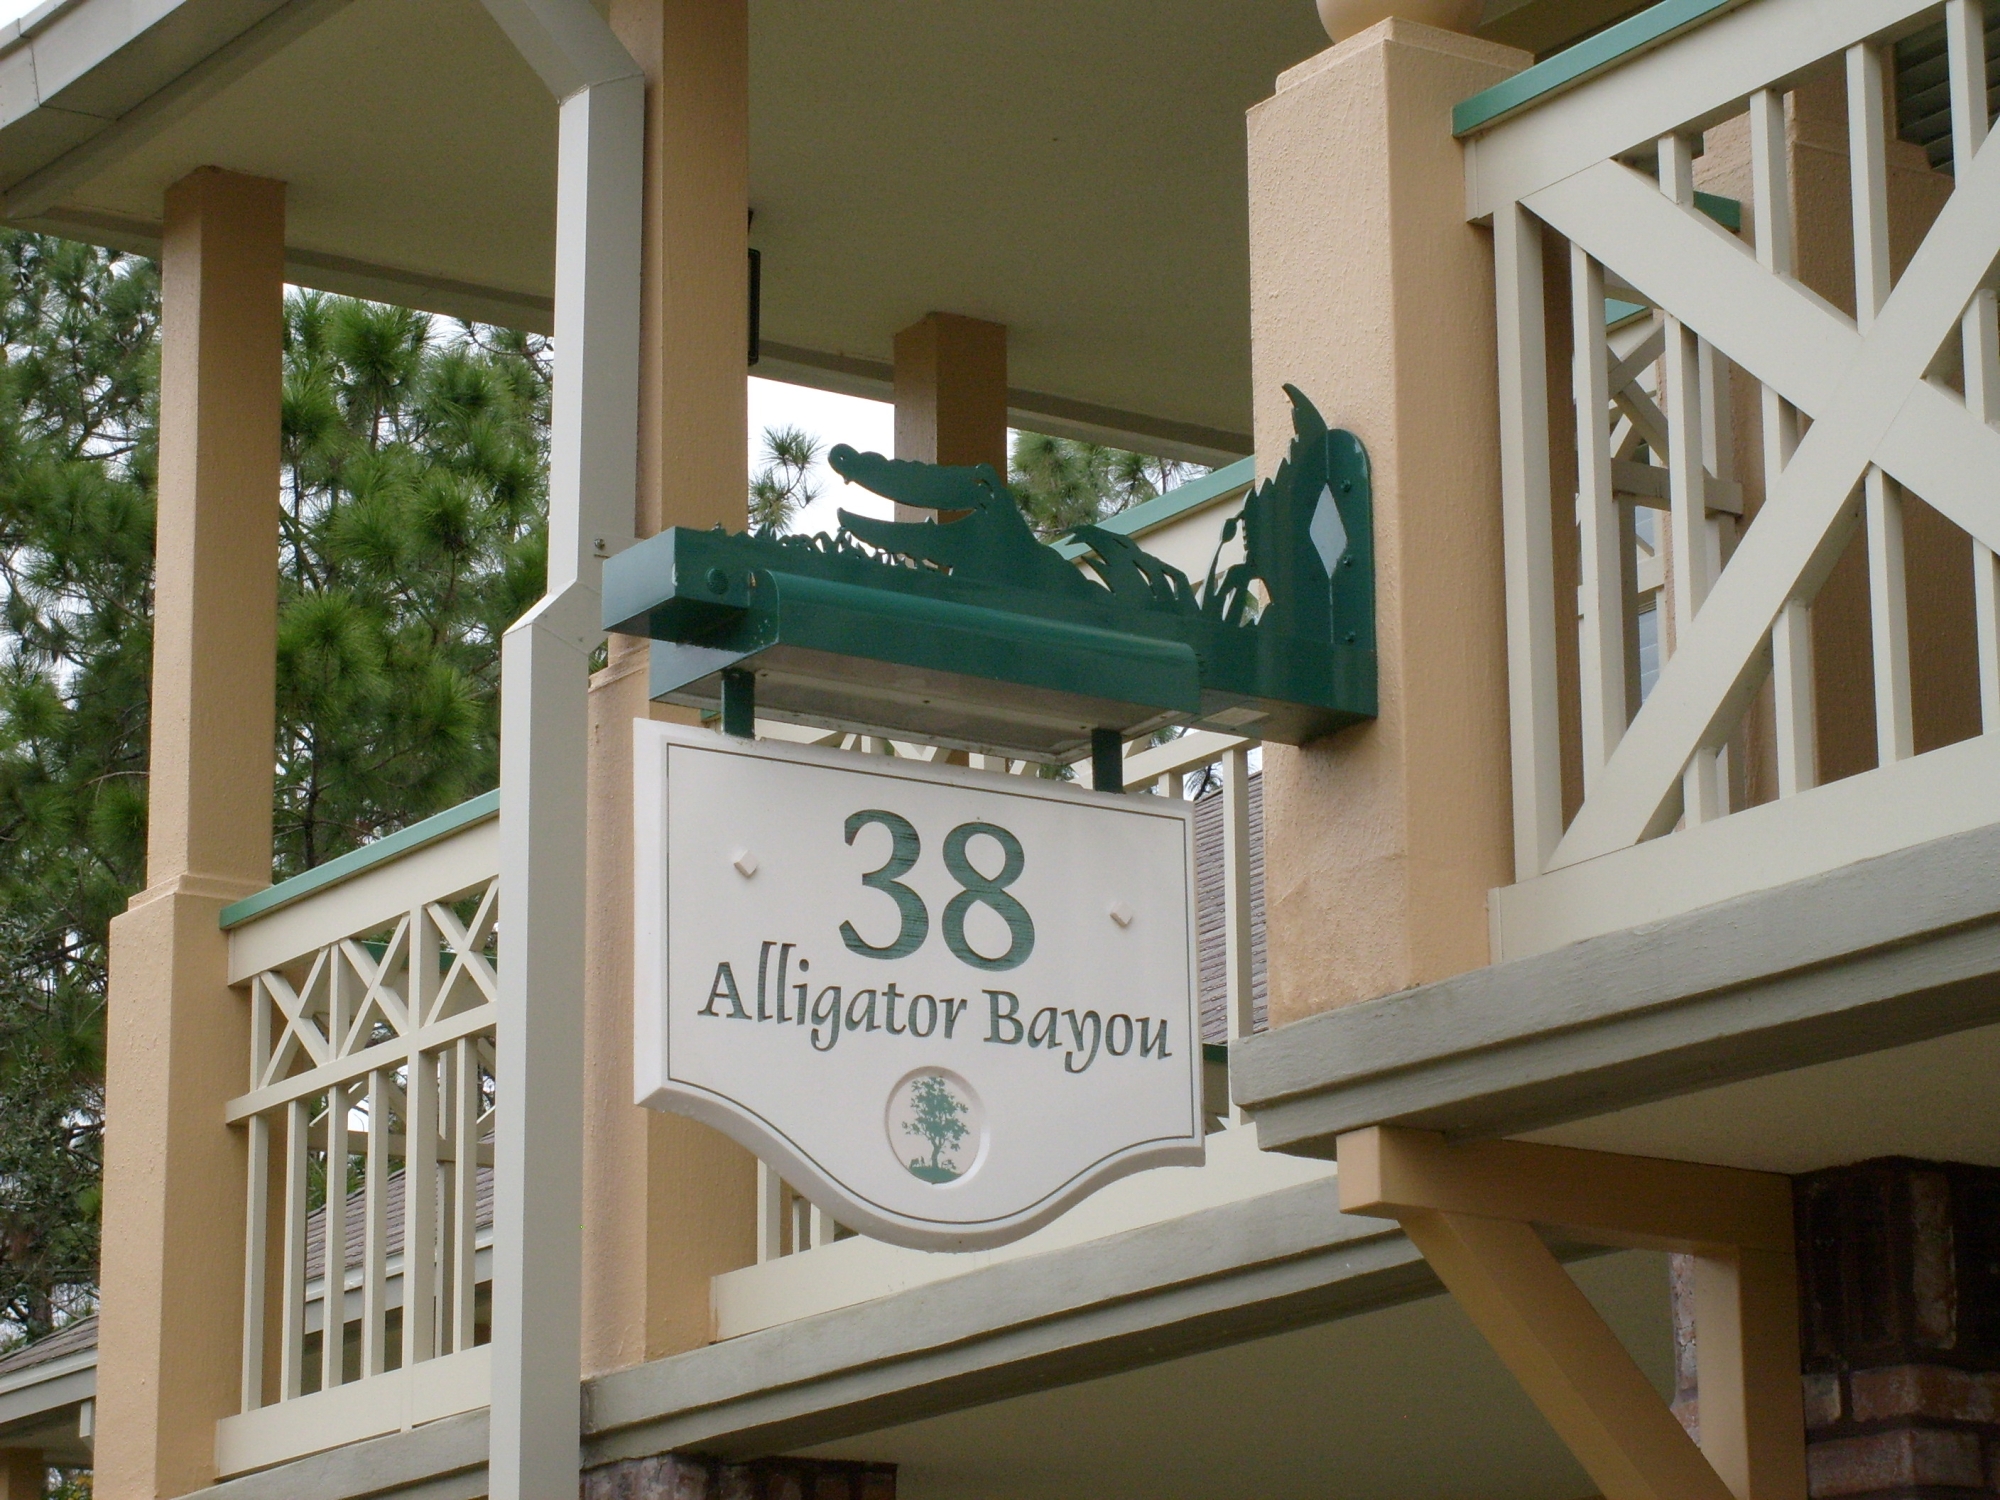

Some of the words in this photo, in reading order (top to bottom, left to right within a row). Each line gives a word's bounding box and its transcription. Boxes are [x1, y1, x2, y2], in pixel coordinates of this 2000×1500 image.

[838, 808, 1036, 972] 38
[697, 940, 968, 1052] Alligator
[982, 988, 1173, 1074] Bayou
